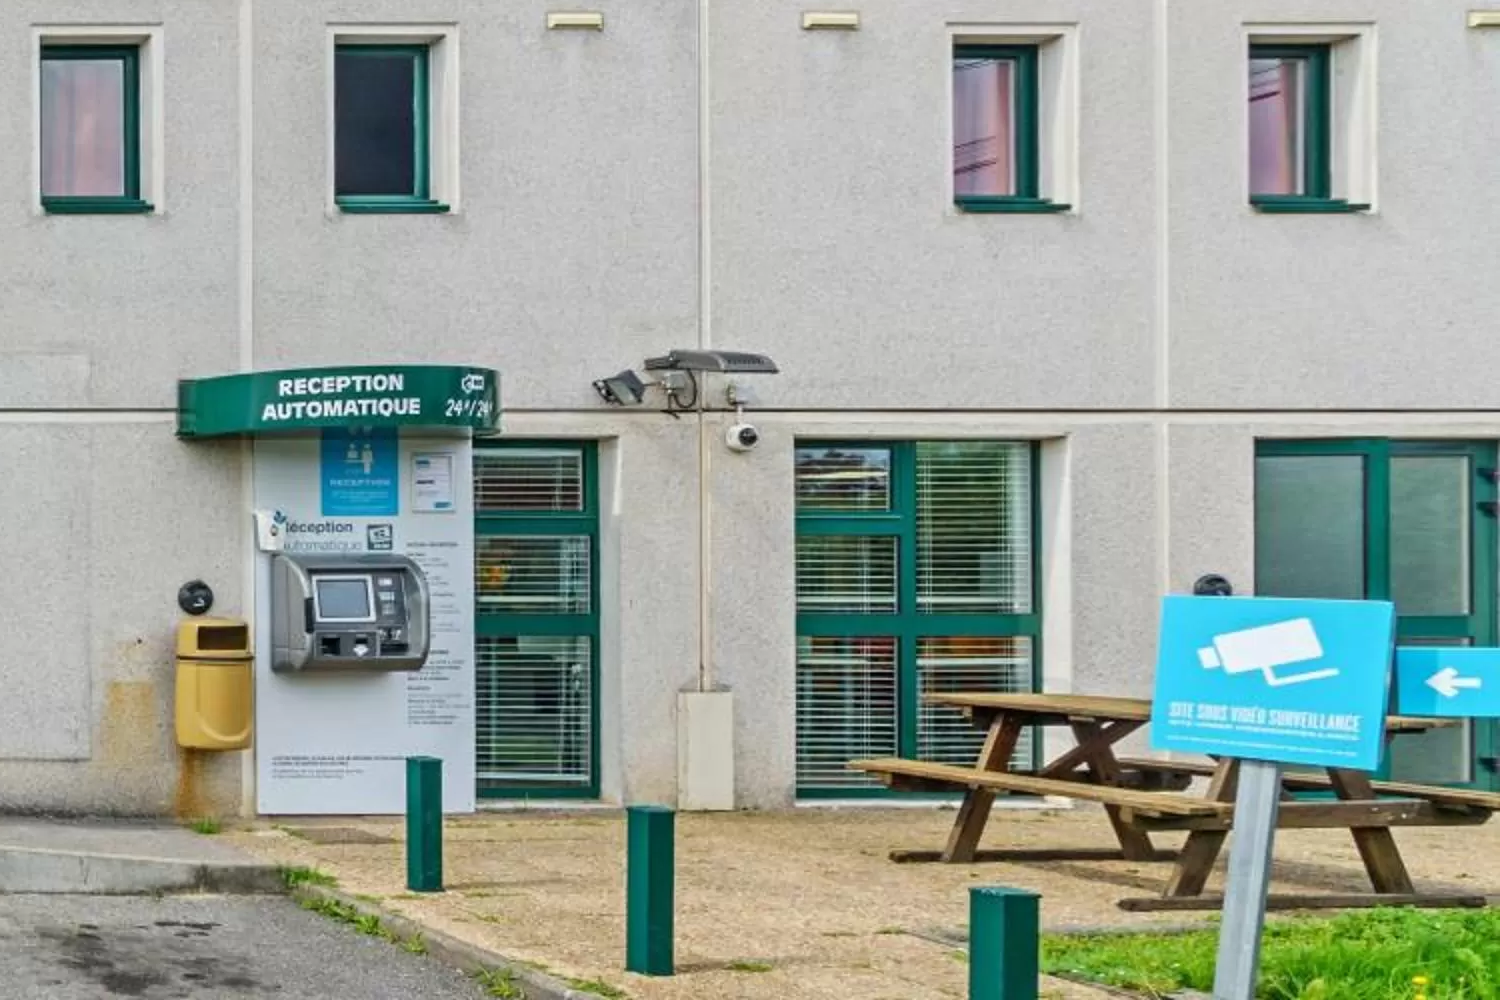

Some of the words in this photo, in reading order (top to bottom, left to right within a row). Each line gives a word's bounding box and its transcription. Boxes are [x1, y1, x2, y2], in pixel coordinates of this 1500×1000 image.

[278, 373, 405, 396] RECEPTION
[261, 397, 421, 421] AUTOMATIQUE
[1168, 701, 1195, 719] SITE
[1267, 708, 1362, 733] SURVEILLANCE
